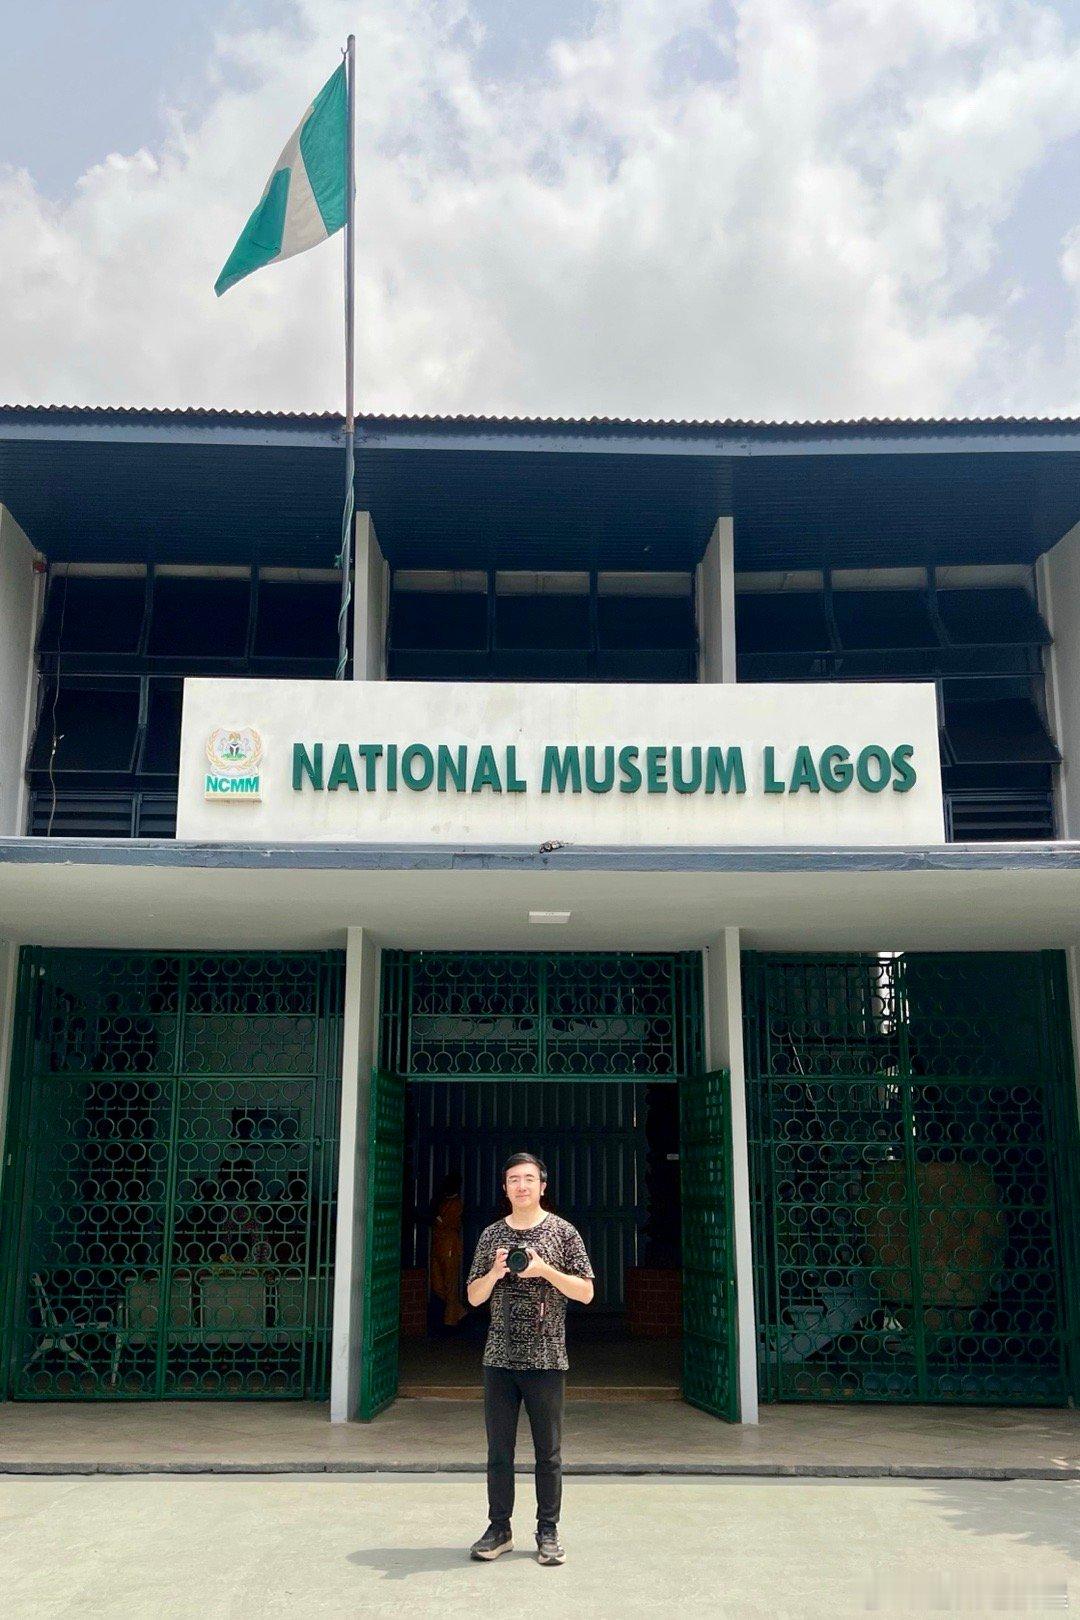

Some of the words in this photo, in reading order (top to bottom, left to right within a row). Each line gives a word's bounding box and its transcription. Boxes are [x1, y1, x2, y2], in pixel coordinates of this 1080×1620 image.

[205, 775, 260, 792] NCMM
[292, 743, 527, 793] NATIONAL
[541, 745, 746, 794] MUSEUM
[763, 744, 917, 794] LAGOS
